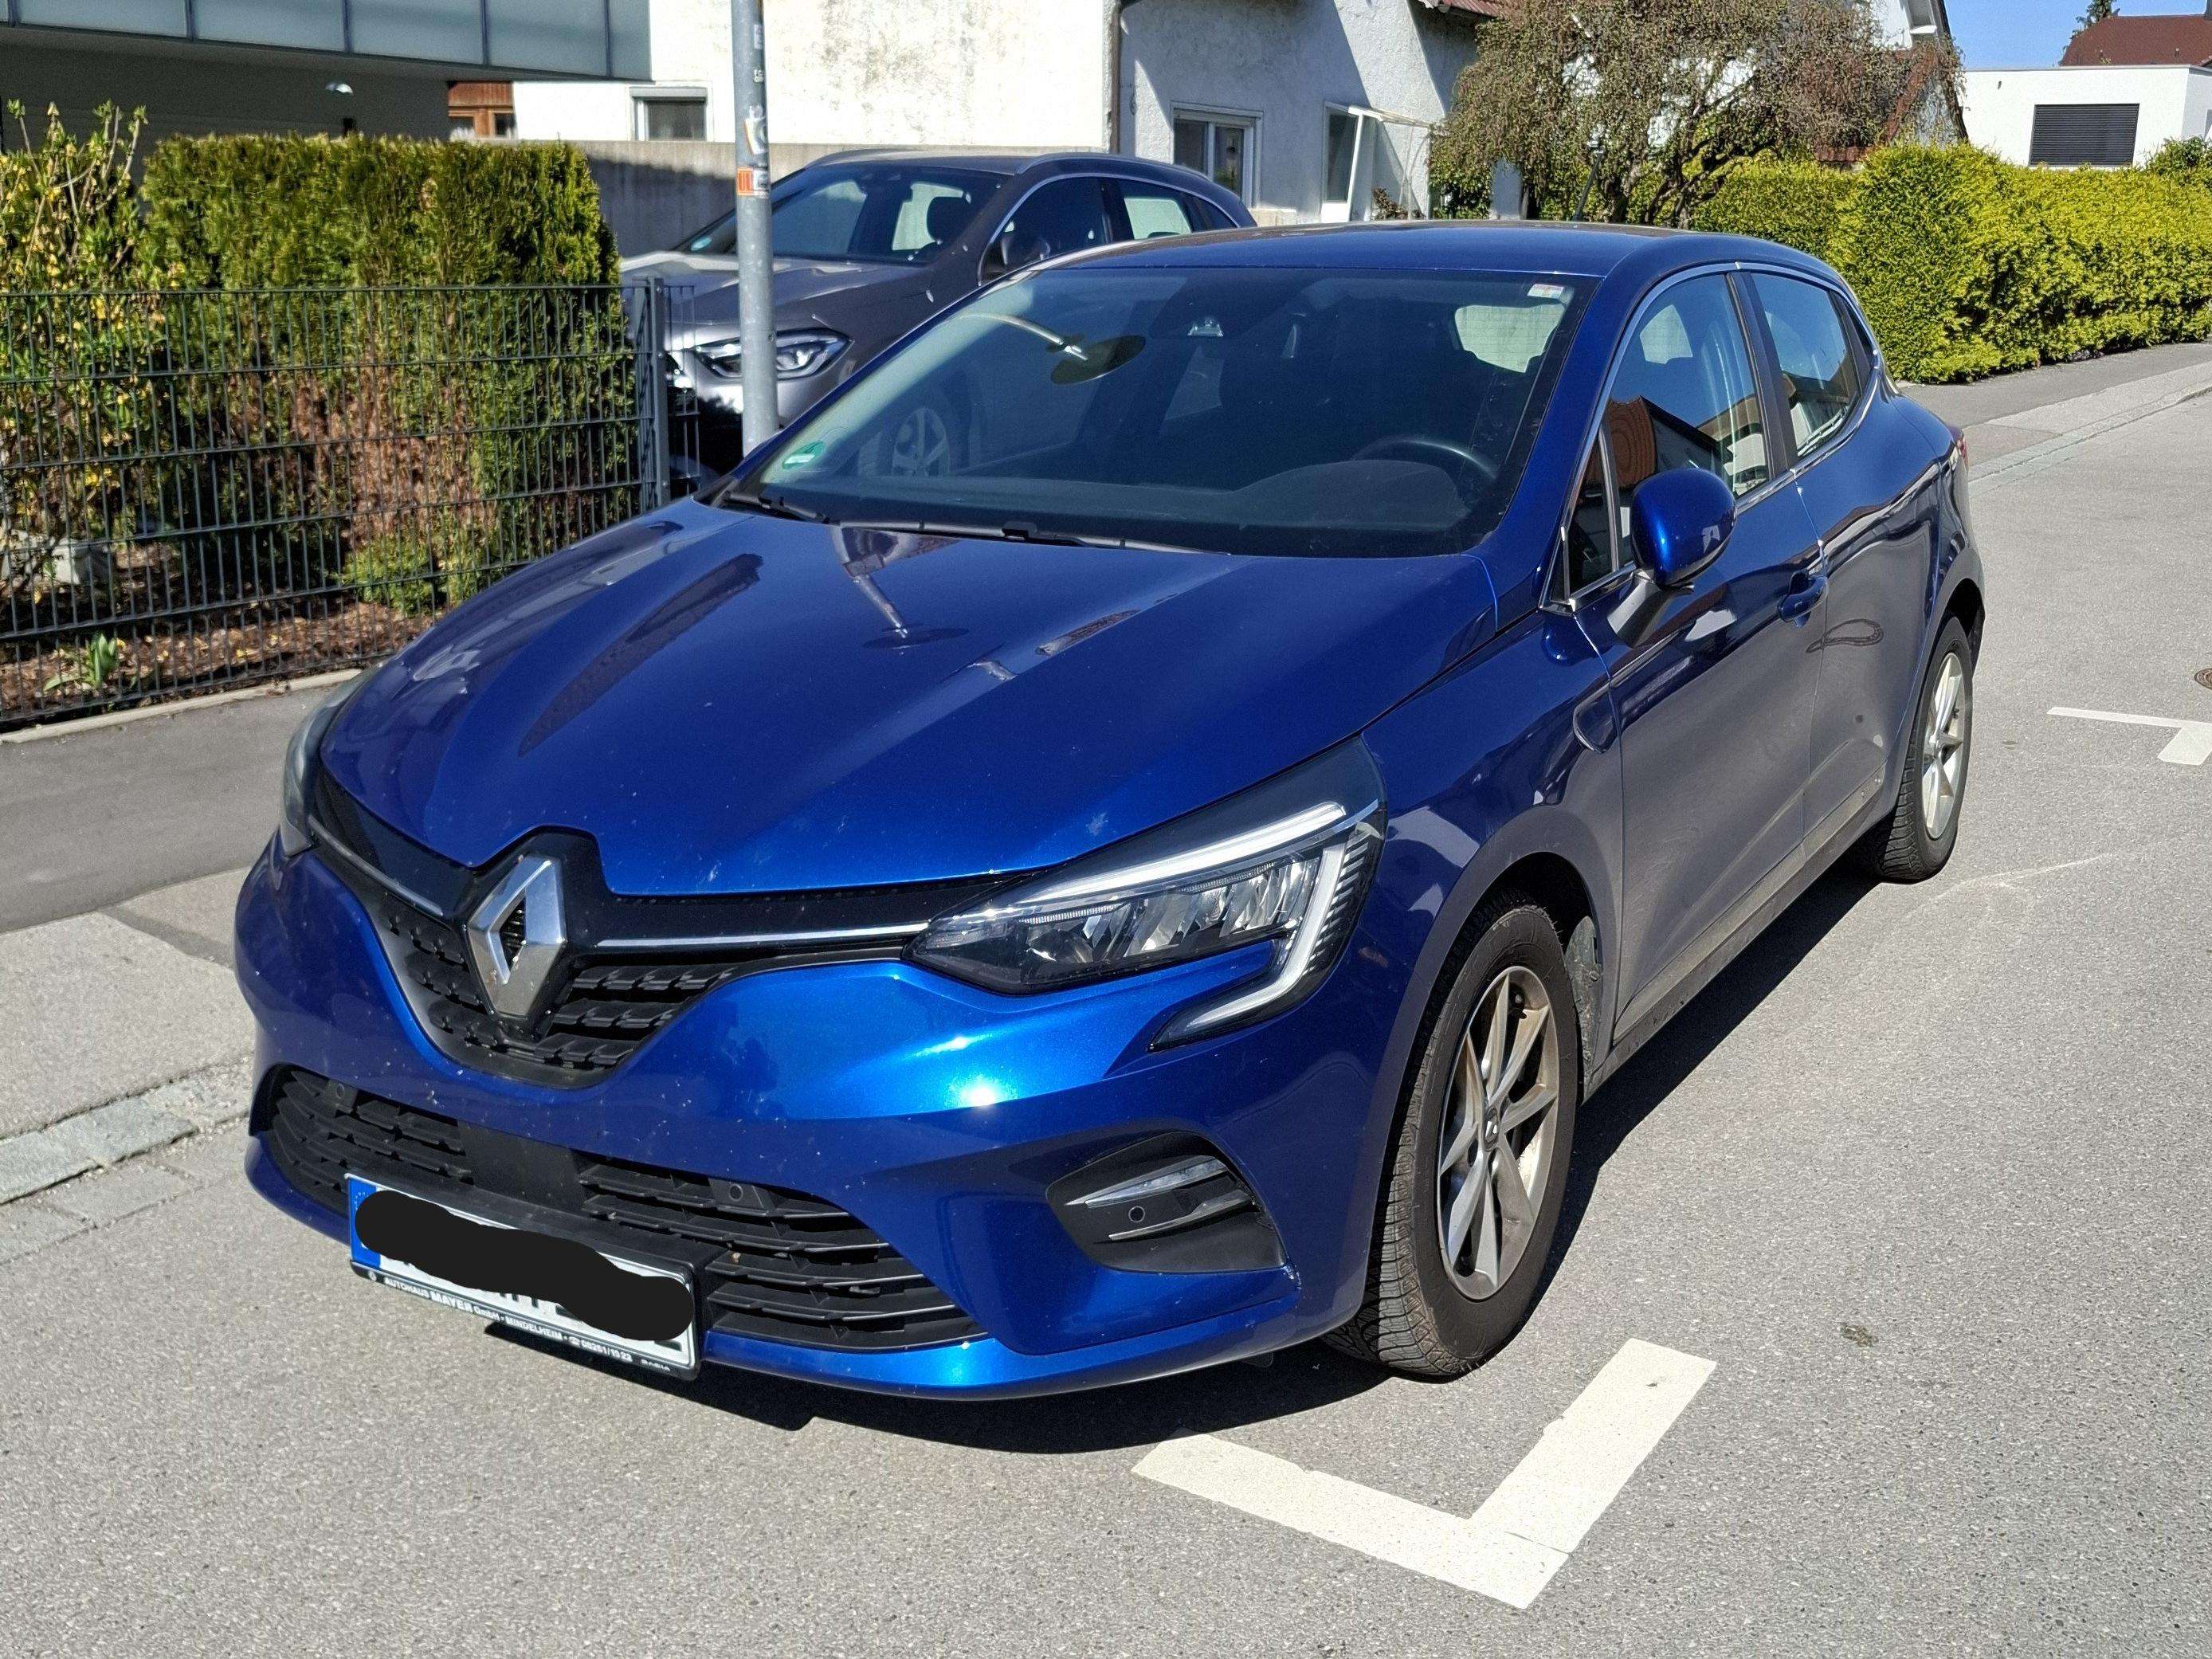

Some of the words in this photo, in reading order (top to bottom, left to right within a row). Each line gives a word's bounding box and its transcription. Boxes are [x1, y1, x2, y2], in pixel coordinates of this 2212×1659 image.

[384, 1277, 430, 1299] AUTOHAUS
[430, 1289, 473, 1313] MAYER
[473, 1304, 500, 1321] GmbH
